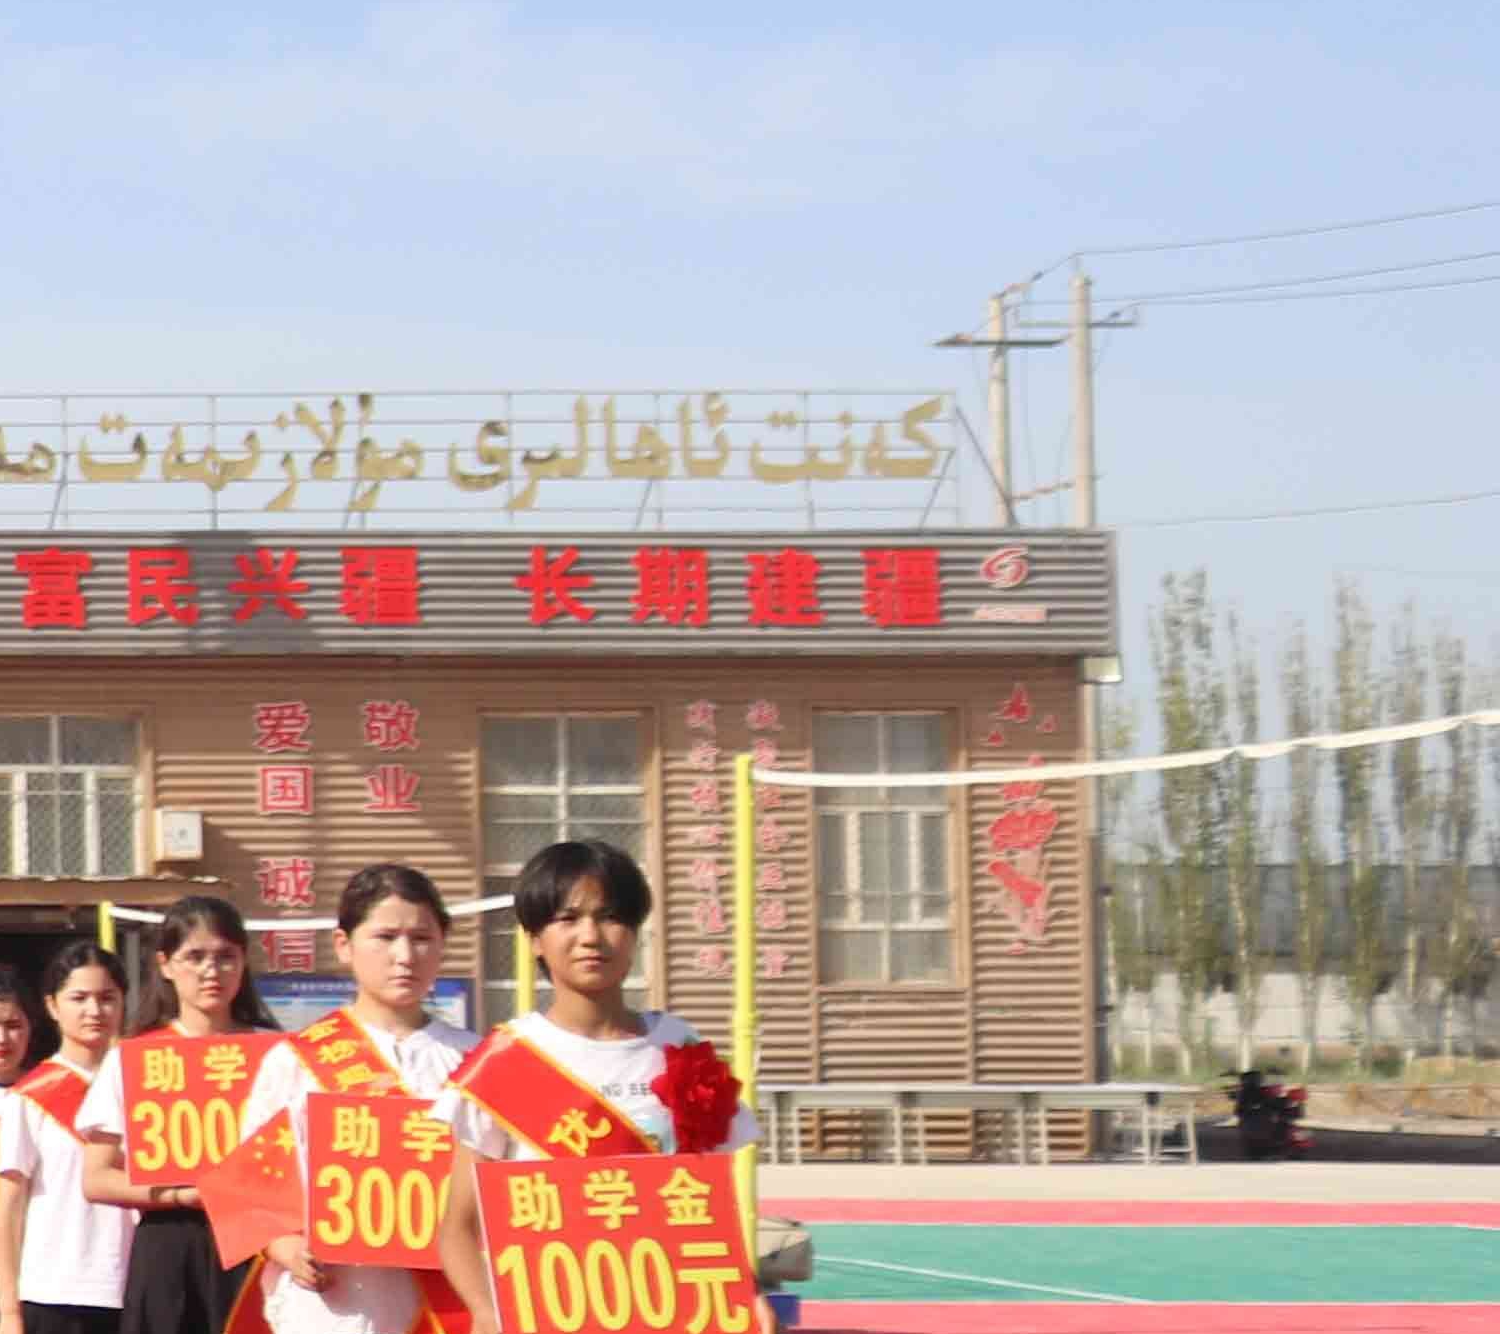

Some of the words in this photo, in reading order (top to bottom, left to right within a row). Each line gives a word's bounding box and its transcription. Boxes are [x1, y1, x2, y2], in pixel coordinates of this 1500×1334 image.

[16, 547, 421, 629] 富民兴疆
[515, 545, 944, 627] 长期建疆
[253, 700, 314, 815] 爱国
[362, 700, 422, 813] 敬业
[255, 858, 317, 972] 诚信
[142, 1044, 248, 1092] 助学
[332, 1105, 453, 1162] 助学
[508, 1167, 714, 1231] 助学金
